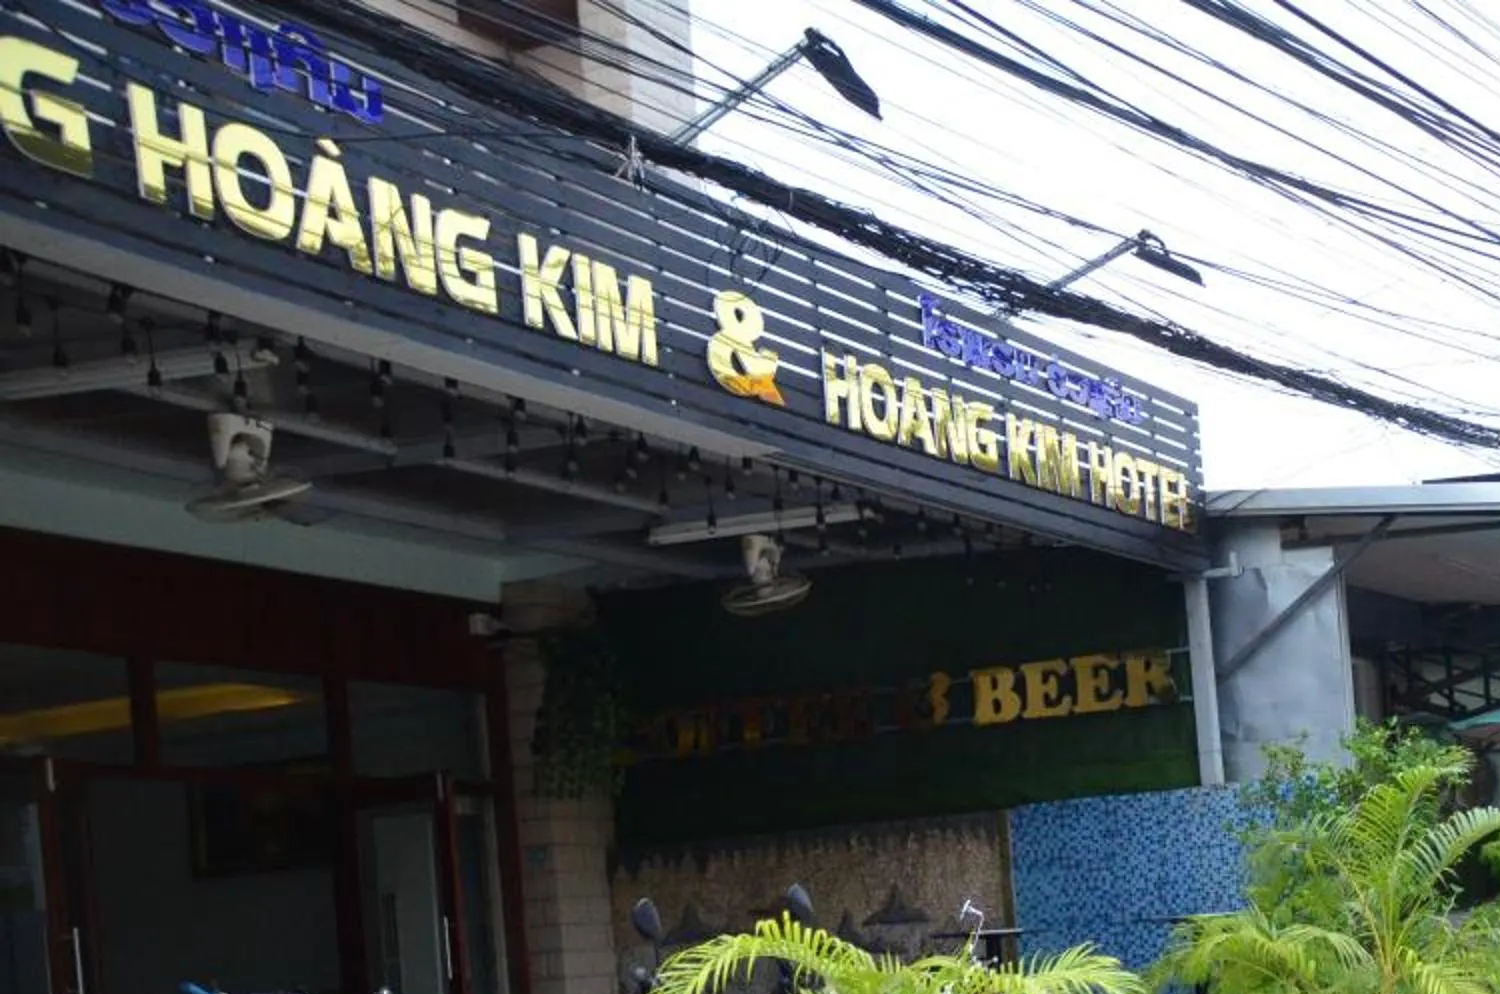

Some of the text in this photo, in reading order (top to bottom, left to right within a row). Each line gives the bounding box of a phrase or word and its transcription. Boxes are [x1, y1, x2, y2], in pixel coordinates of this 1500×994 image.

[127, 82, 498, 314] HOÀNG
[517, 232, 659, 367] KIM
[707, 290, 787, 406] &
[821, 347, 1000, 472] HOANG
[1004, 412, 1083, 497] KIM
[969, 648, 1174, 727] BEER
